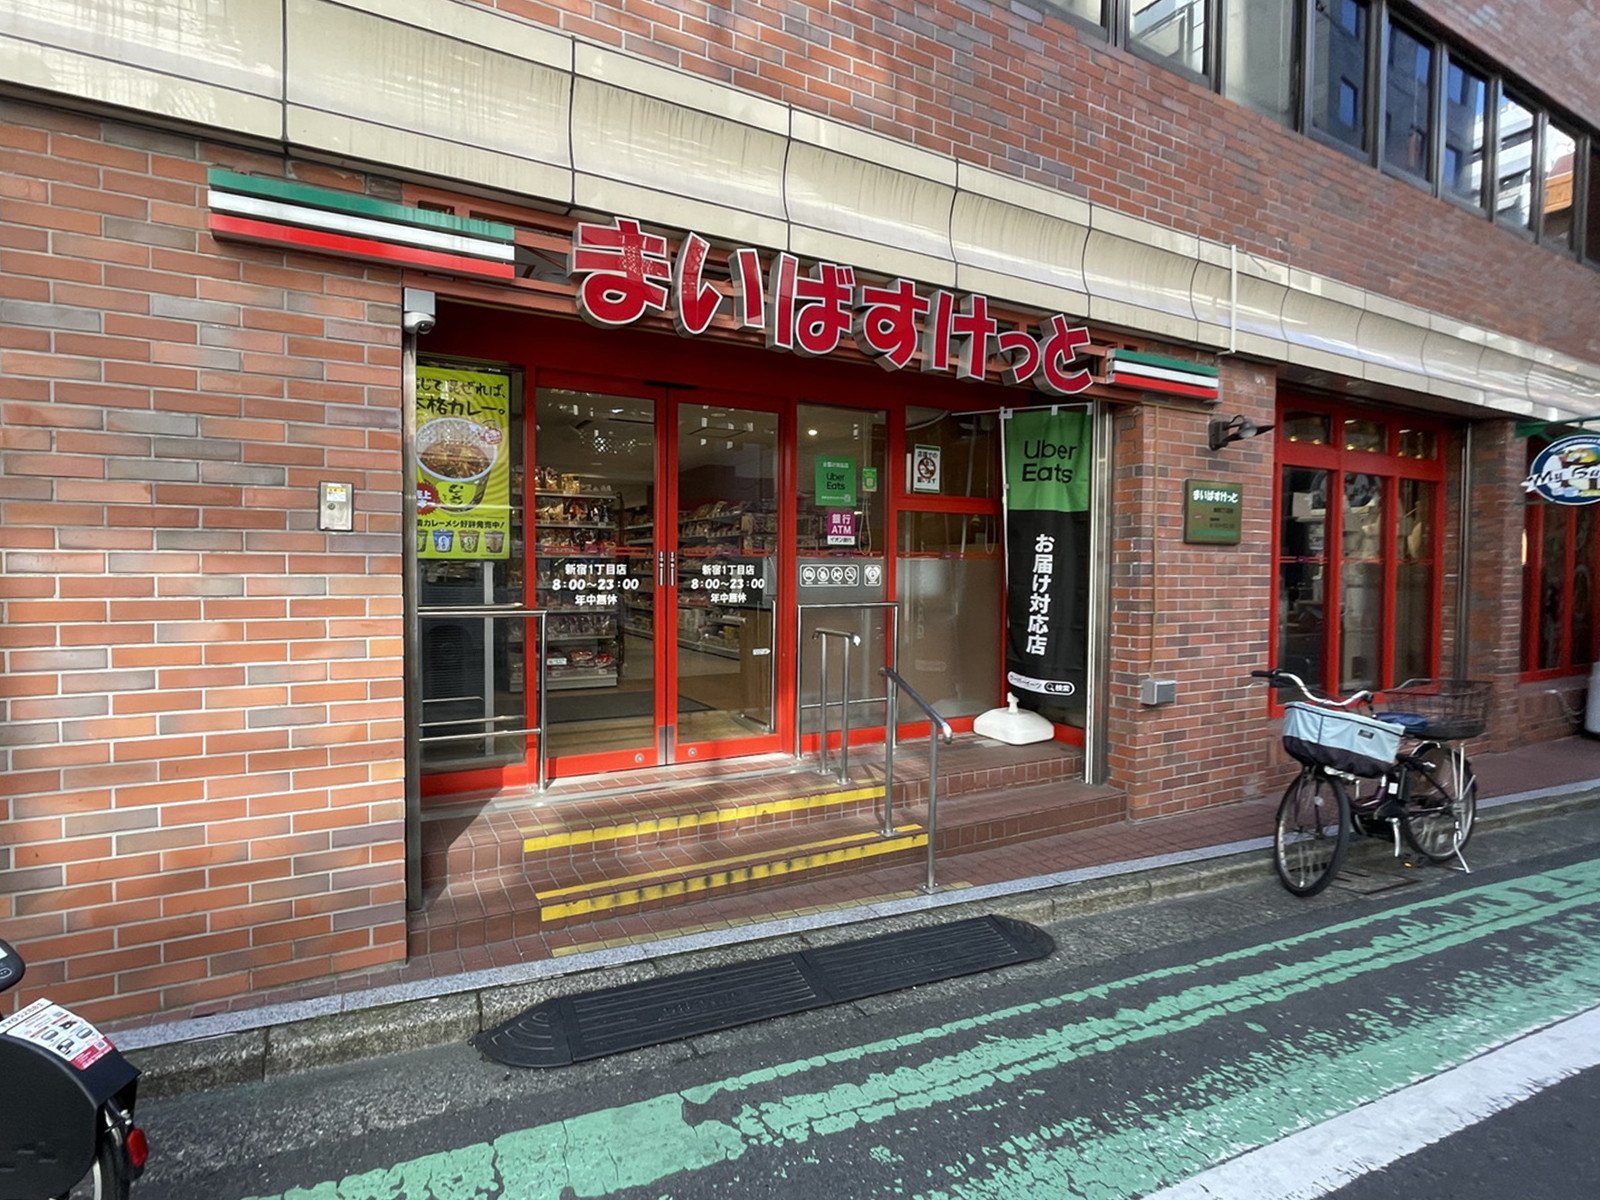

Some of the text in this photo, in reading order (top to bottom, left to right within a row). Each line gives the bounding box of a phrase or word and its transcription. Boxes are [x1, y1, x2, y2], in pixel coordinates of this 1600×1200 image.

[573, 216, 1094, 396] まいばすけっと
[416, 377, 505, 398] じて混ぜれば、
[1024, 440, 1077, 460] Uber
[826, 472, 845, 482] Uber
[1021, 463, 1073, 484] Eats
[826, 482, 845, 491] Eats
[1193, 489, 1239, 504] まいばすけっと
[832, 513, 851, 525] 銀行
[831, 525, 851, 535] ATM
[565, 563, 627, 575] 新宿1丁目店
[702, 564, 755, 576] 新宿1丁目店
[575, 594, 618, 606] 年中無休
[711, 592, 747, 603] 年中無休
[1026, 534, 1055, 656] お届け対応店
